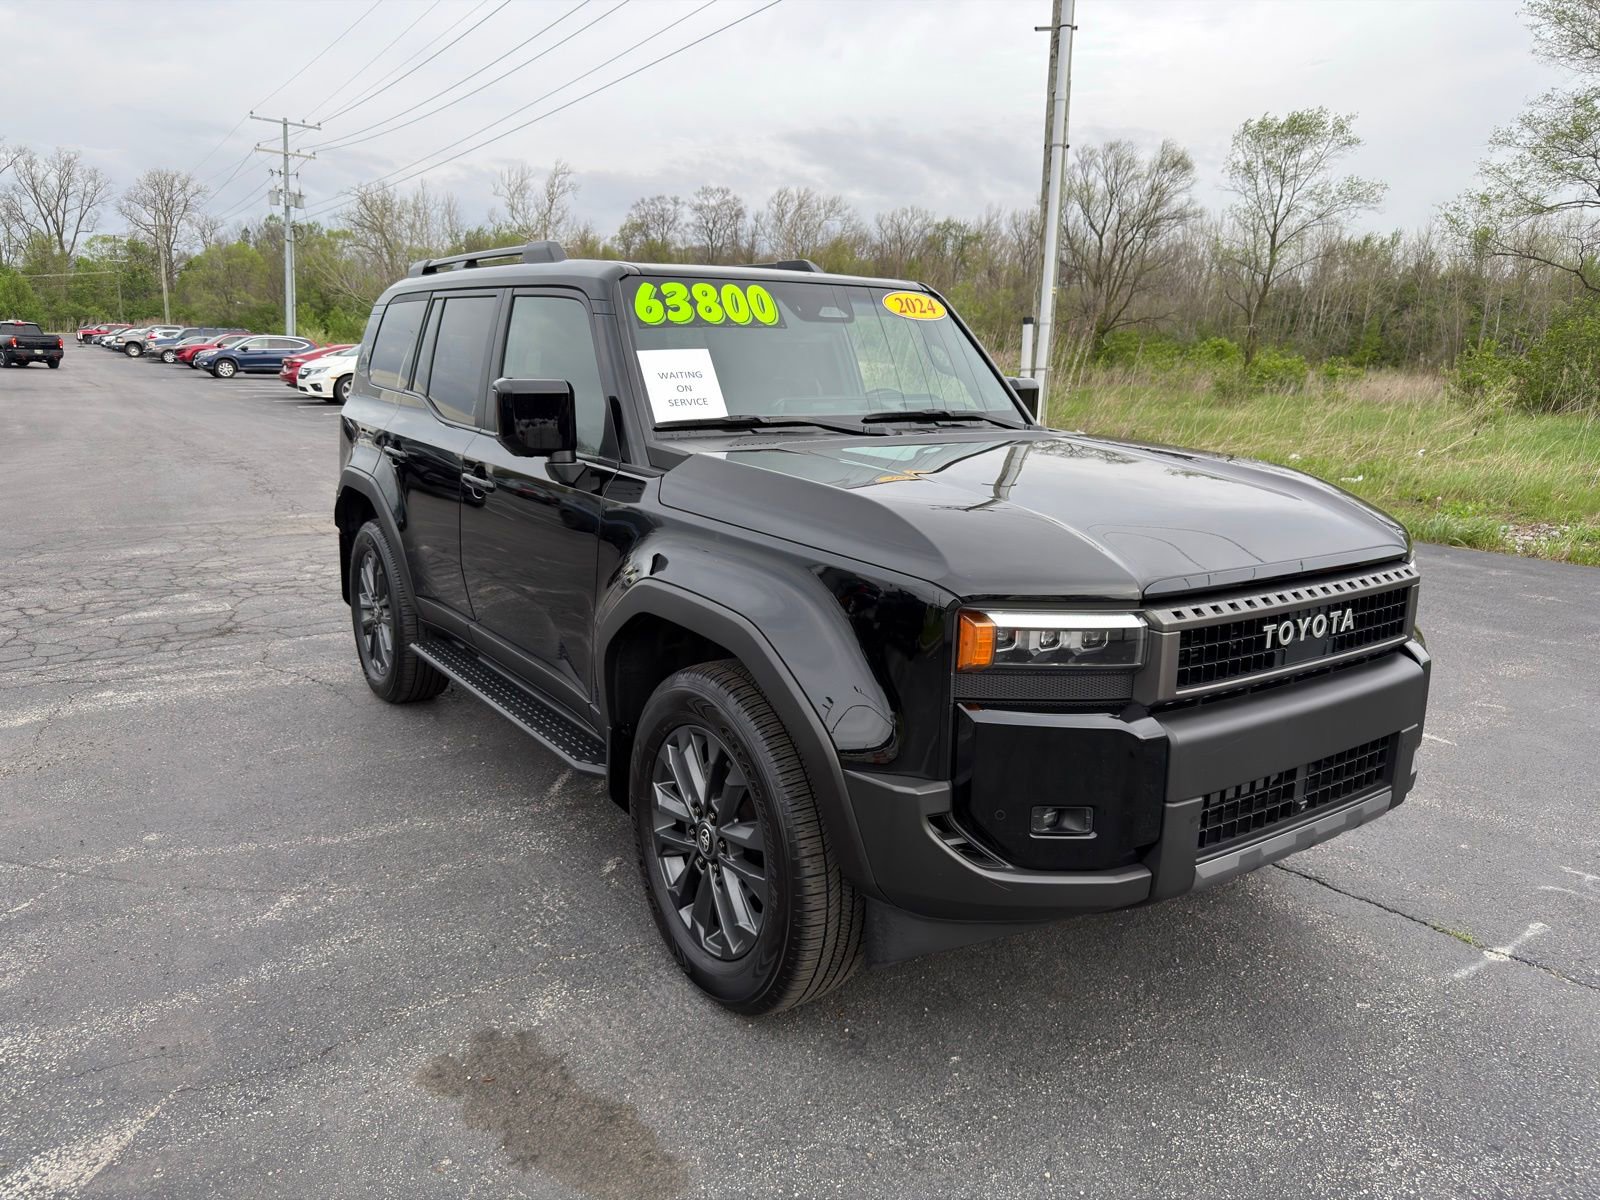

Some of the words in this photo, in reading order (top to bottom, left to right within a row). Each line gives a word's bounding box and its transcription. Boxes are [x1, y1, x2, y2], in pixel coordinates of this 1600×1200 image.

[635, 282, 779, 326] 63800
[895, 297, 936, 314] 2024
[657, 370, 703, 380] WAITING
[676, 384, 693, 393] ON
[668, 397, 709, 407] SERVICE
[1263, 608, 1354, 649] TOYOTA
